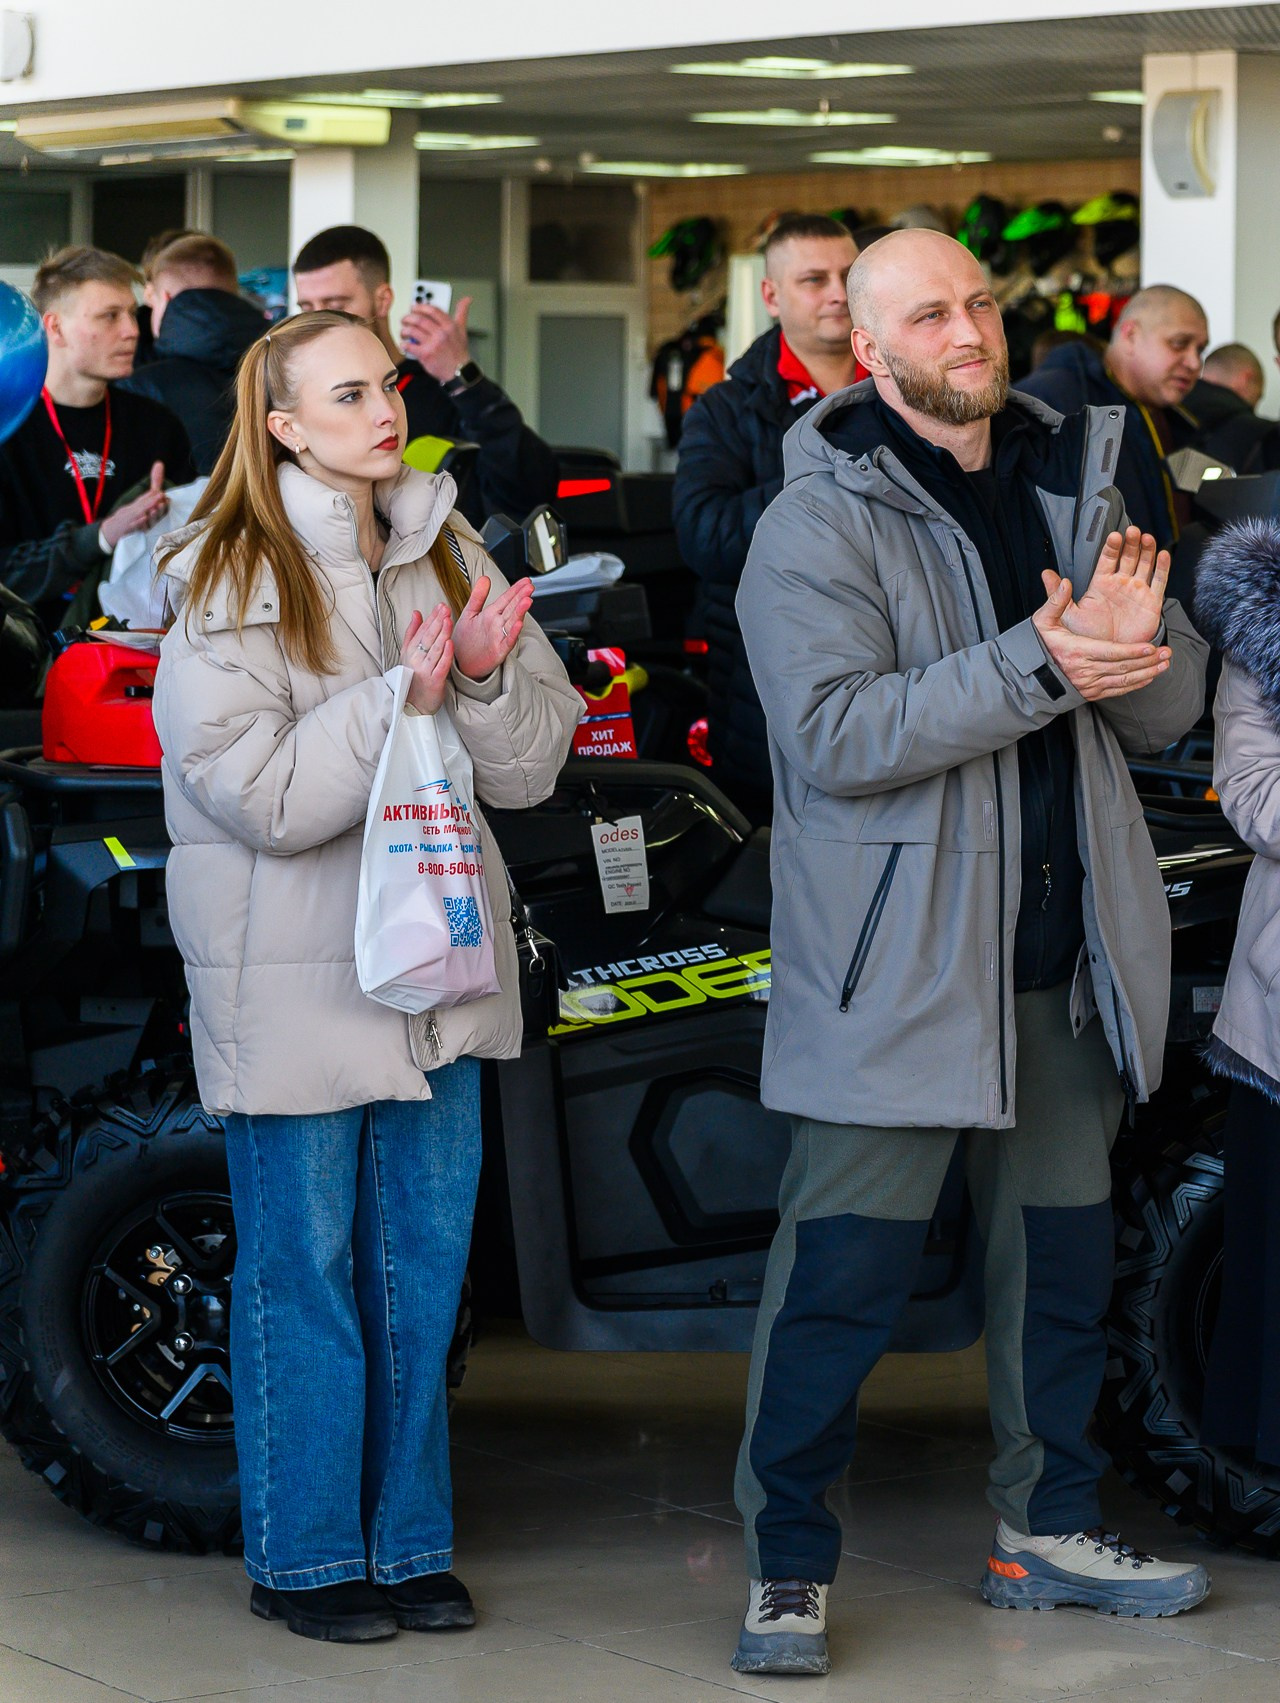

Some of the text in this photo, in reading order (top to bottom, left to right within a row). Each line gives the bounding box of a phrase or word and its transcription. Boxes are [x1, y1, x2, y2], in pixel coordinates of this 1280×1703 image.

[591, 729, 614, 742] ХИТ
[577, 741, 632, 756] ПРОДАЖ
[422, 826, 440, 835] СЕТЬ
[600, 828, 639, 844] odes
[388, 844, 413, 853] ОХОТА
[419, 843, 452, 853] РЫБАЛКА
